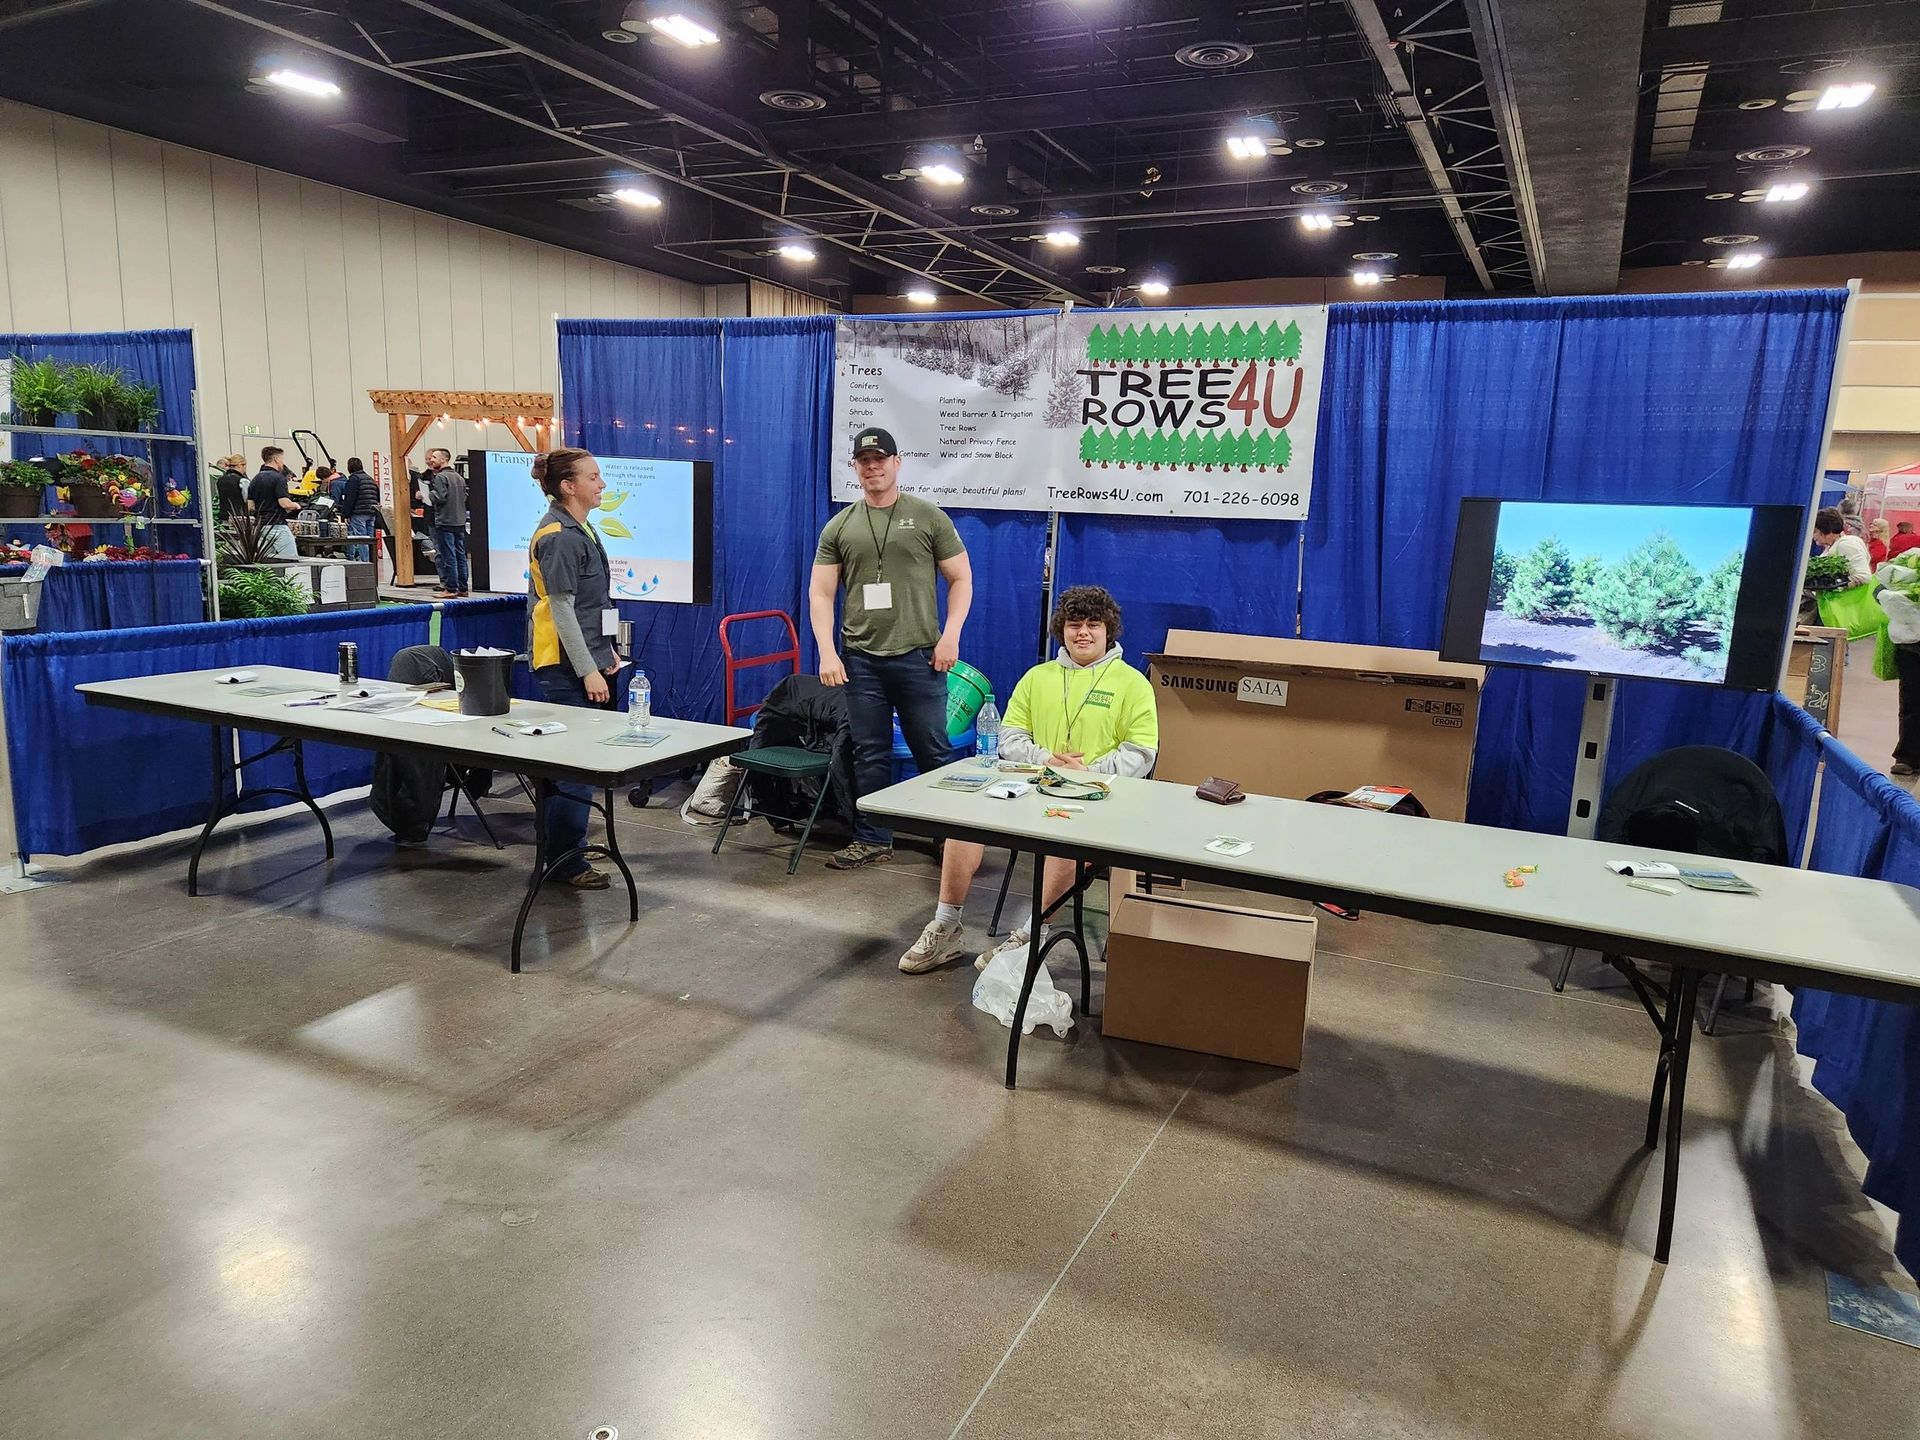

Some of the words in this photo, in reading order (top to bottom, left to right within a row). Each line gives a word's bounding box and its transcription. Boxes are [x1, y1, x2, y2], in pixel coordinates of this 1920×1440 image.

[849, 364, 882, 376] Trees
[849, 381, 879, 390] Conifers
[1076, 368, 1235, 399] TREE
[849, 395, 884, 403] Deciduous
[940, 397, 966, 406] Planting
[1227, 366, 1304, 429] 4U
[849, 408, 874, 416] Shrubs
[991, 410, 997, 418] &
[1000, 411, 1033, 420] Irrigation
[1081, 398, 1226, 428] ROWS
[848, 421, 866, 429] Fruit
[940, 424, 956, 432] Tree
[958, 424, 977, 432] Rows
[969, 438, 994, 447] Privacy
[996, 438, 1017, 446] Fence
[898, 450, 930, 458] Container
[974, 451, 992, 459] Snow
[994, 451, 1014, 459] Block
[382, 455, 391, 506] ARIEN
[918, 484, 931, 493] for
[932, 485, 959, 495] unique,
[962, 486, 1000, 495] beautiful
[1001, 487, 1027, 498] plans!
[1047, 486, 1163, 502] TreeRows4U.com
[1183, 490, 1300, 506] 701-226-6098
[1160, 674, 1238, 693] SAMSUNG
[1242, 679, 1283, 697] SAIA
[1434, 718, 1461, 727] FRONT
